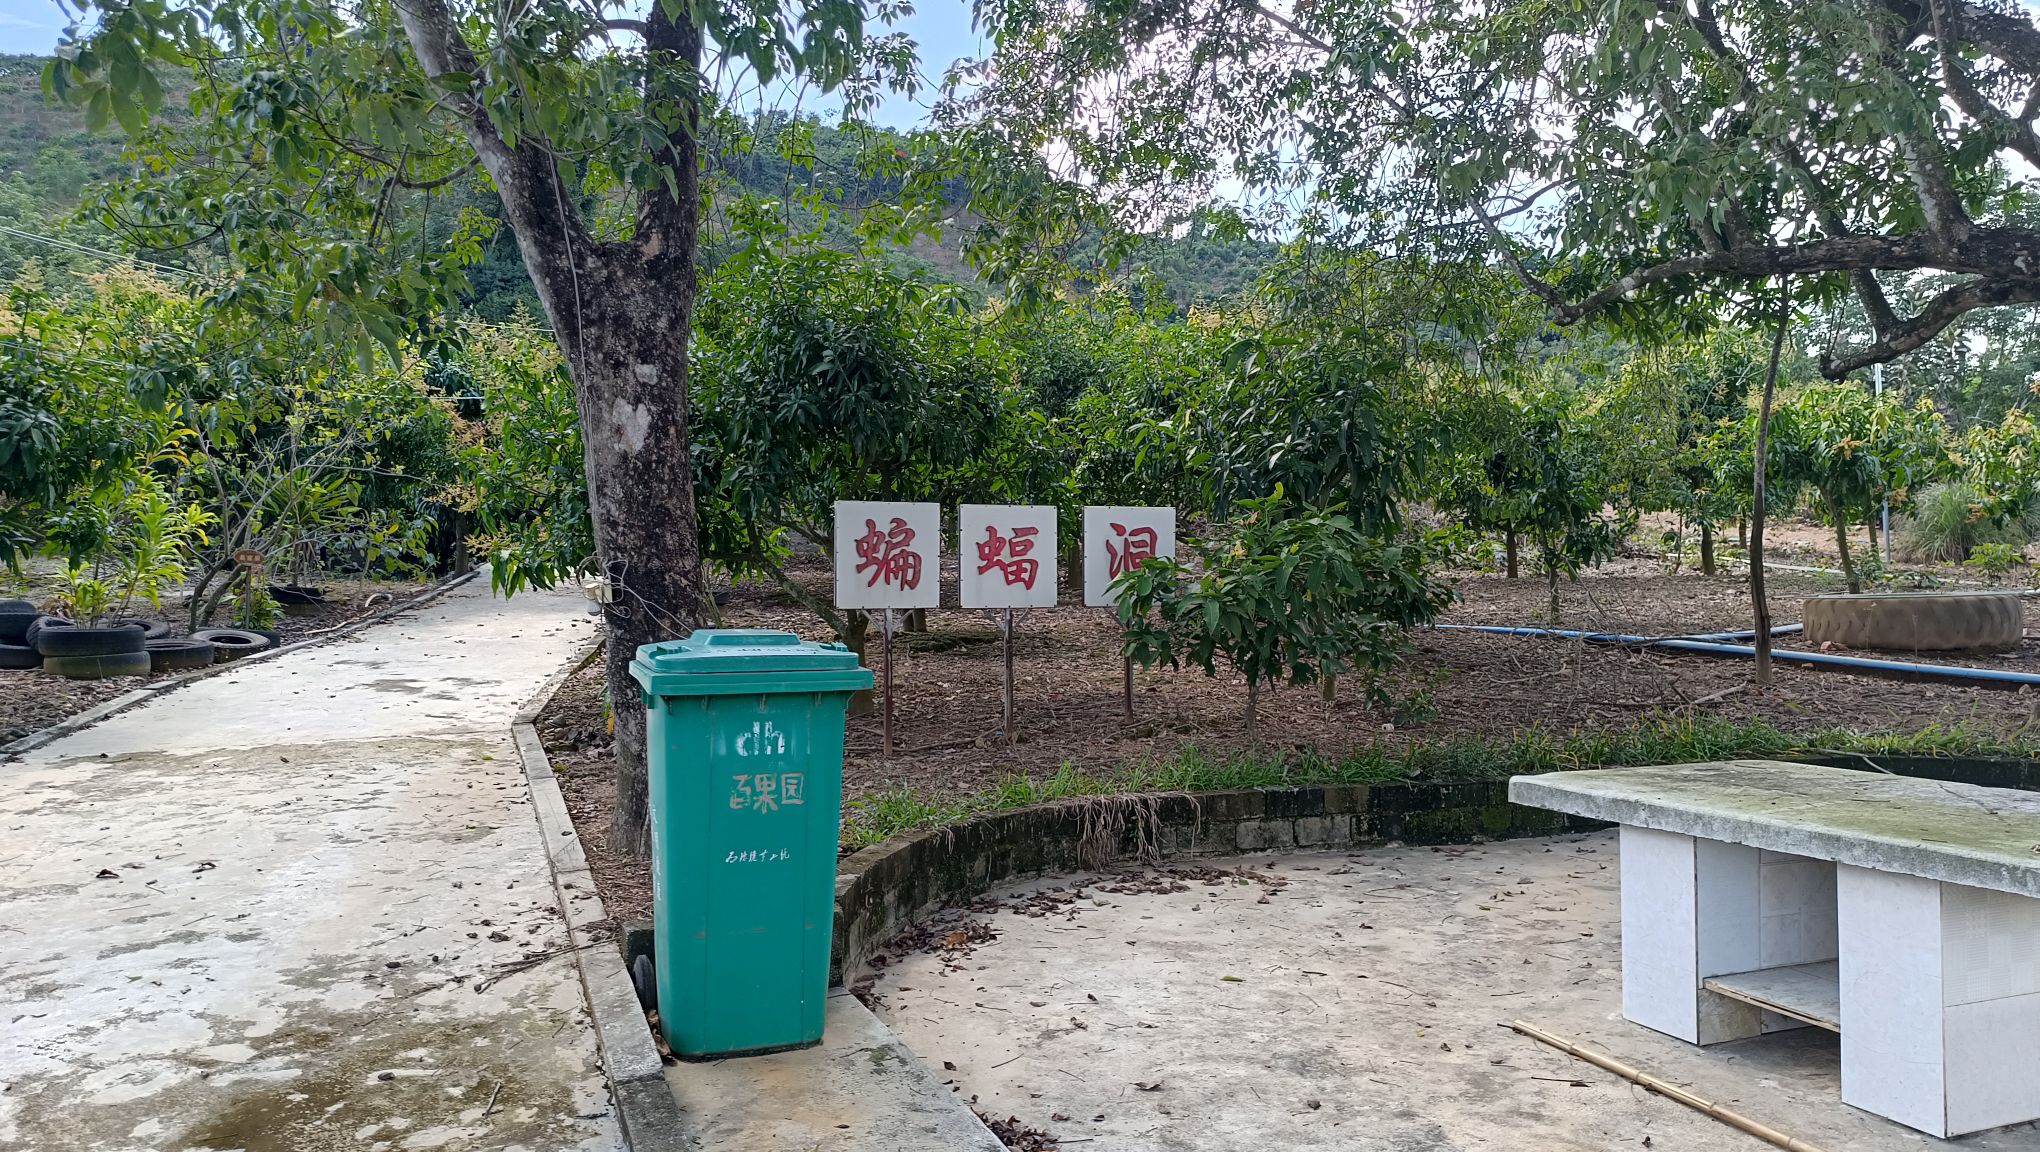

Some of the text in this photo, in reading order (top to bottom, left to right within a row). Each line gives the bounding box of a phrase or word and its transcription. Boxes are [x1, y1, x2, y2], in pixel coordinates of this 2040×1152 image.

[855, 517, 1158, 591] 蝙蝠洞
[729, 772, 804, 814] 百果园
